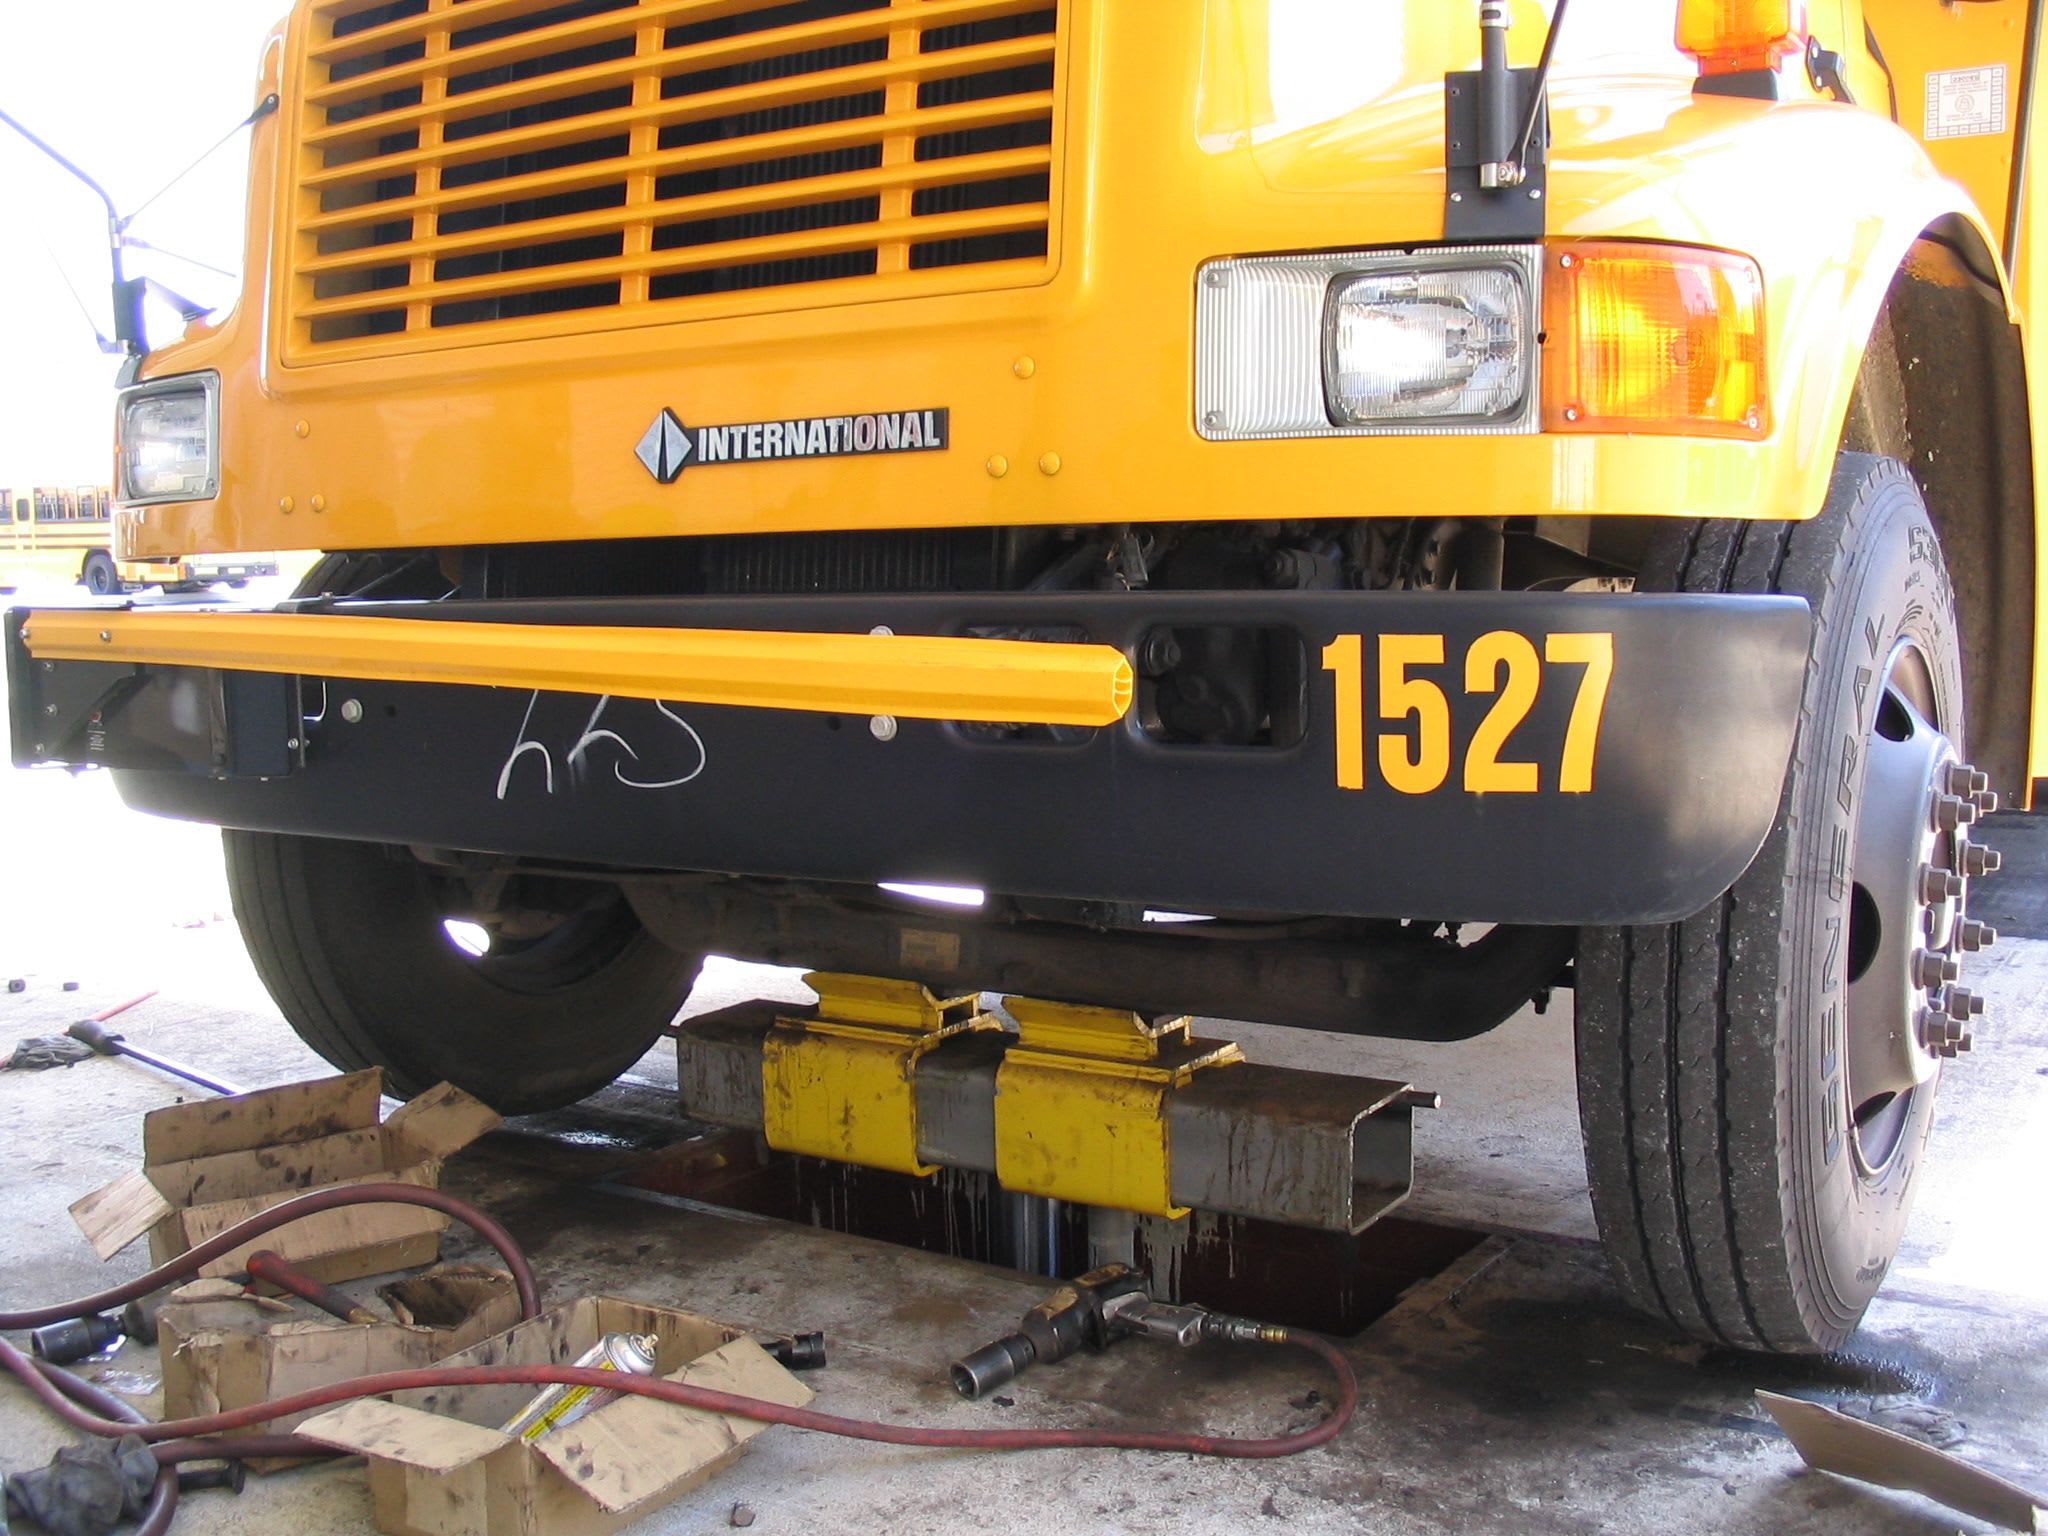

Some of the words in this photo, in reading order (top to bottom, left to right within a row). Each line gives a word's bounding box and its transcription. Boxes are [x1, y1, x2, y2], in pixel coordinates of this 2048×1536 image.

[698, 410, 941, 463] INTERNATIONAL
[1321, 629, 1615, 795] 1527
[1820, 612, 1886, 1167] GENERAL
